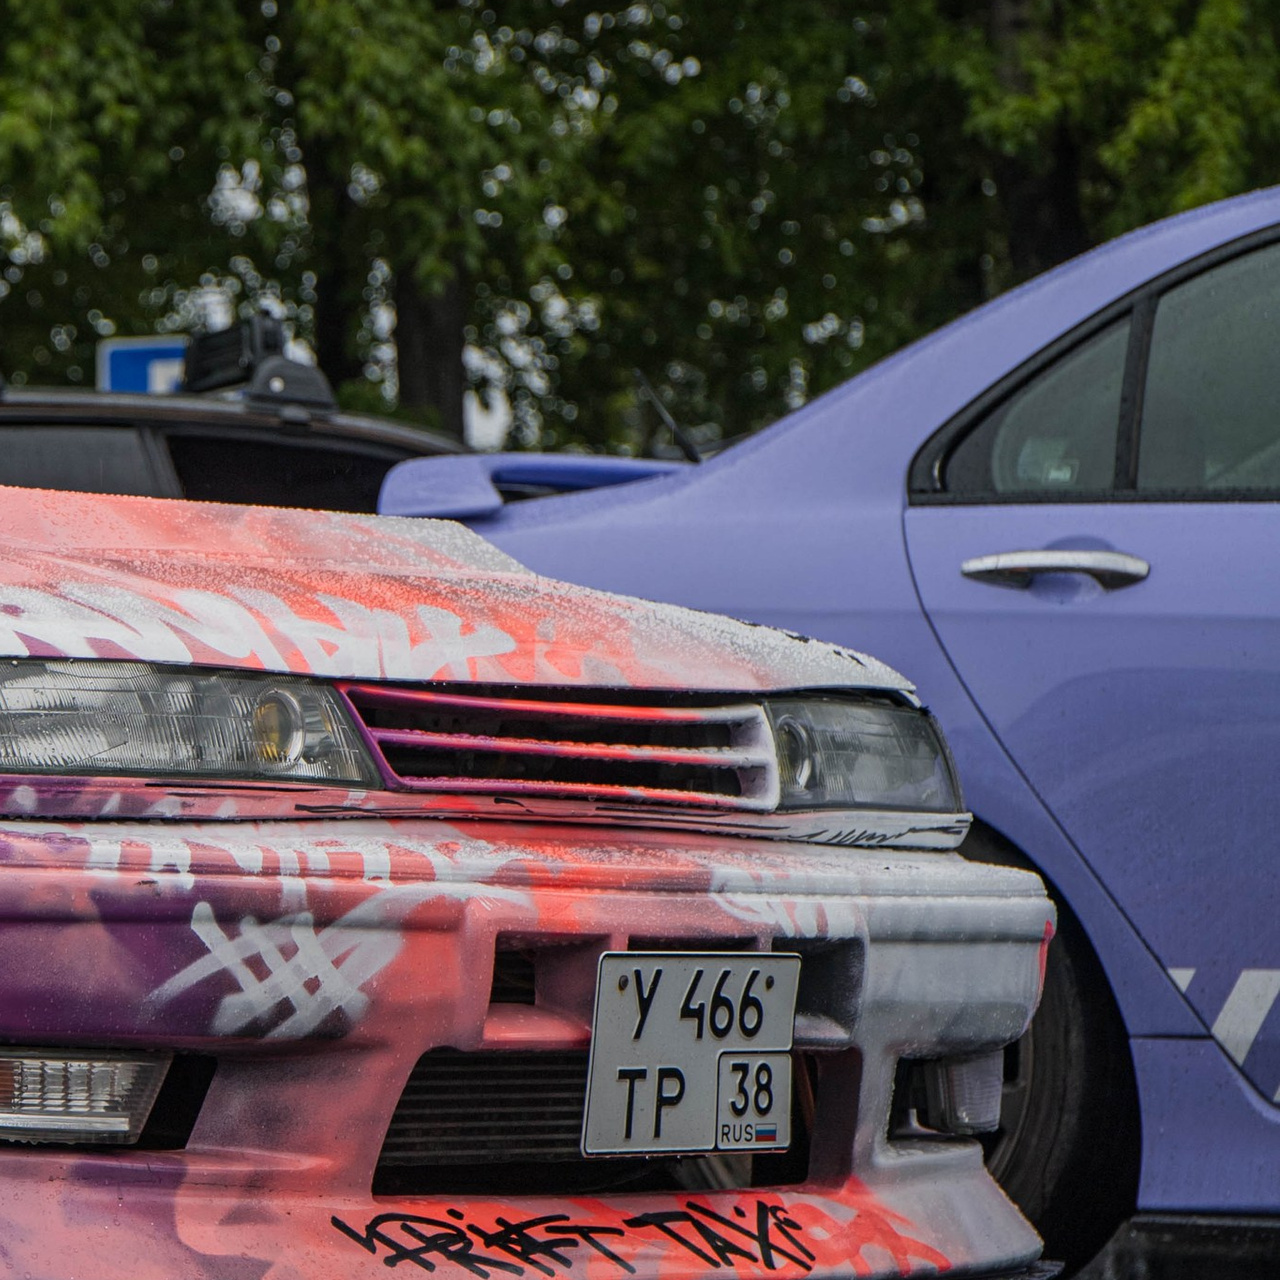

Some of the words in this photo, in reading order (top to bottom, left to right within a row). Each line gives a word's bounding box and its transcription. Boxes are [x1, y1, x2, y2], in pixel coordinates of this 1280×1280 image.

[679, 968, 764, 1040] 466
[729, 1061, 774, 1117] 38
[721, 1123, 754, 1144] RUS
